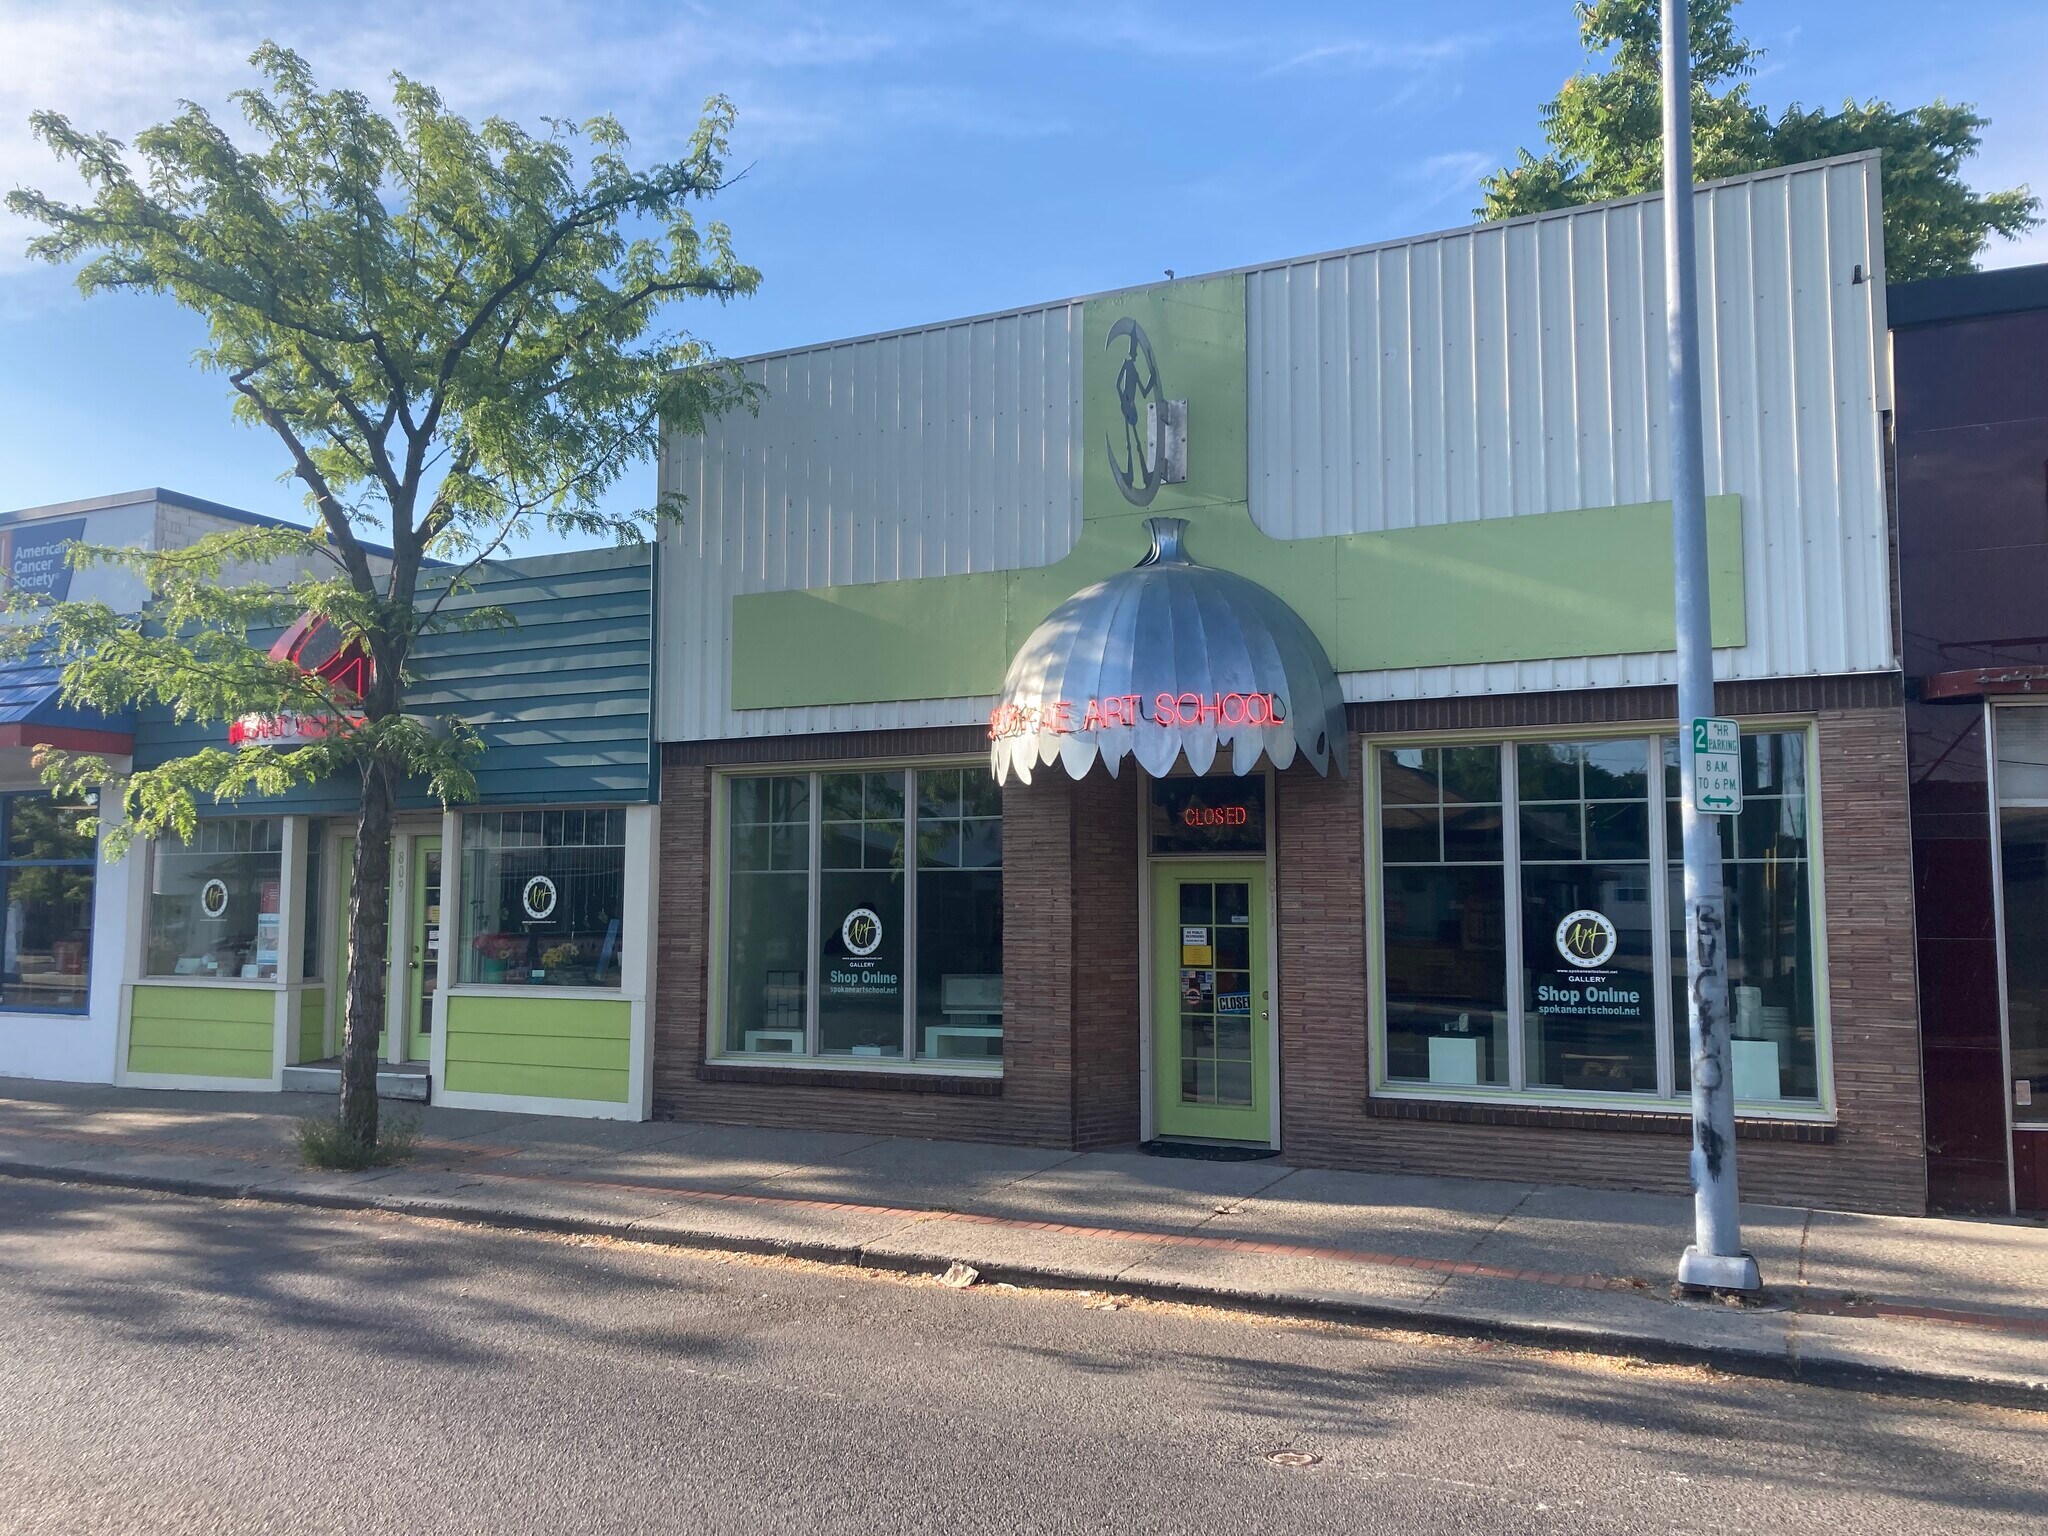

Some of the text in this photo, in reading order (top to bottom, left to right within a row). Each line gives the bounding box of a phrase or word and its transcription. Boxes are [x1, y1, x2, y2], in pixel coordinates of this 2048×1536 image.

[15, 541, 69, 560] American
[14, 559, 53, 574] Cancer
[1083, 695, 1142, 729] ART
[1155, 692, 1285, 725] SCHOOL
[1695, 725, 1706, 748] 2
[1717, 725, 1729, 736] HR
[1708, 739, 1737, 752] PARKING
[1706, 761, 1712, 772] 8
[1698, 777, 1709, 789] TO
[1714, 779, 1720, 790] 6
[1184, 807, 1247, 825] CLOSED
[1566, 920, 1608, 957] Art
[830, 970, 898, 986] Shop Online
[1568, 975, 1606, 983] GALLERY
[830, 985, 898, 994] spokaneartschool.net
[1538, 985, 1640, 1006] Shop Online
[1219, 996, 1250, 1010] CLOSE
[1538, 1004, 1641, 1016] spokaneartschool.net
